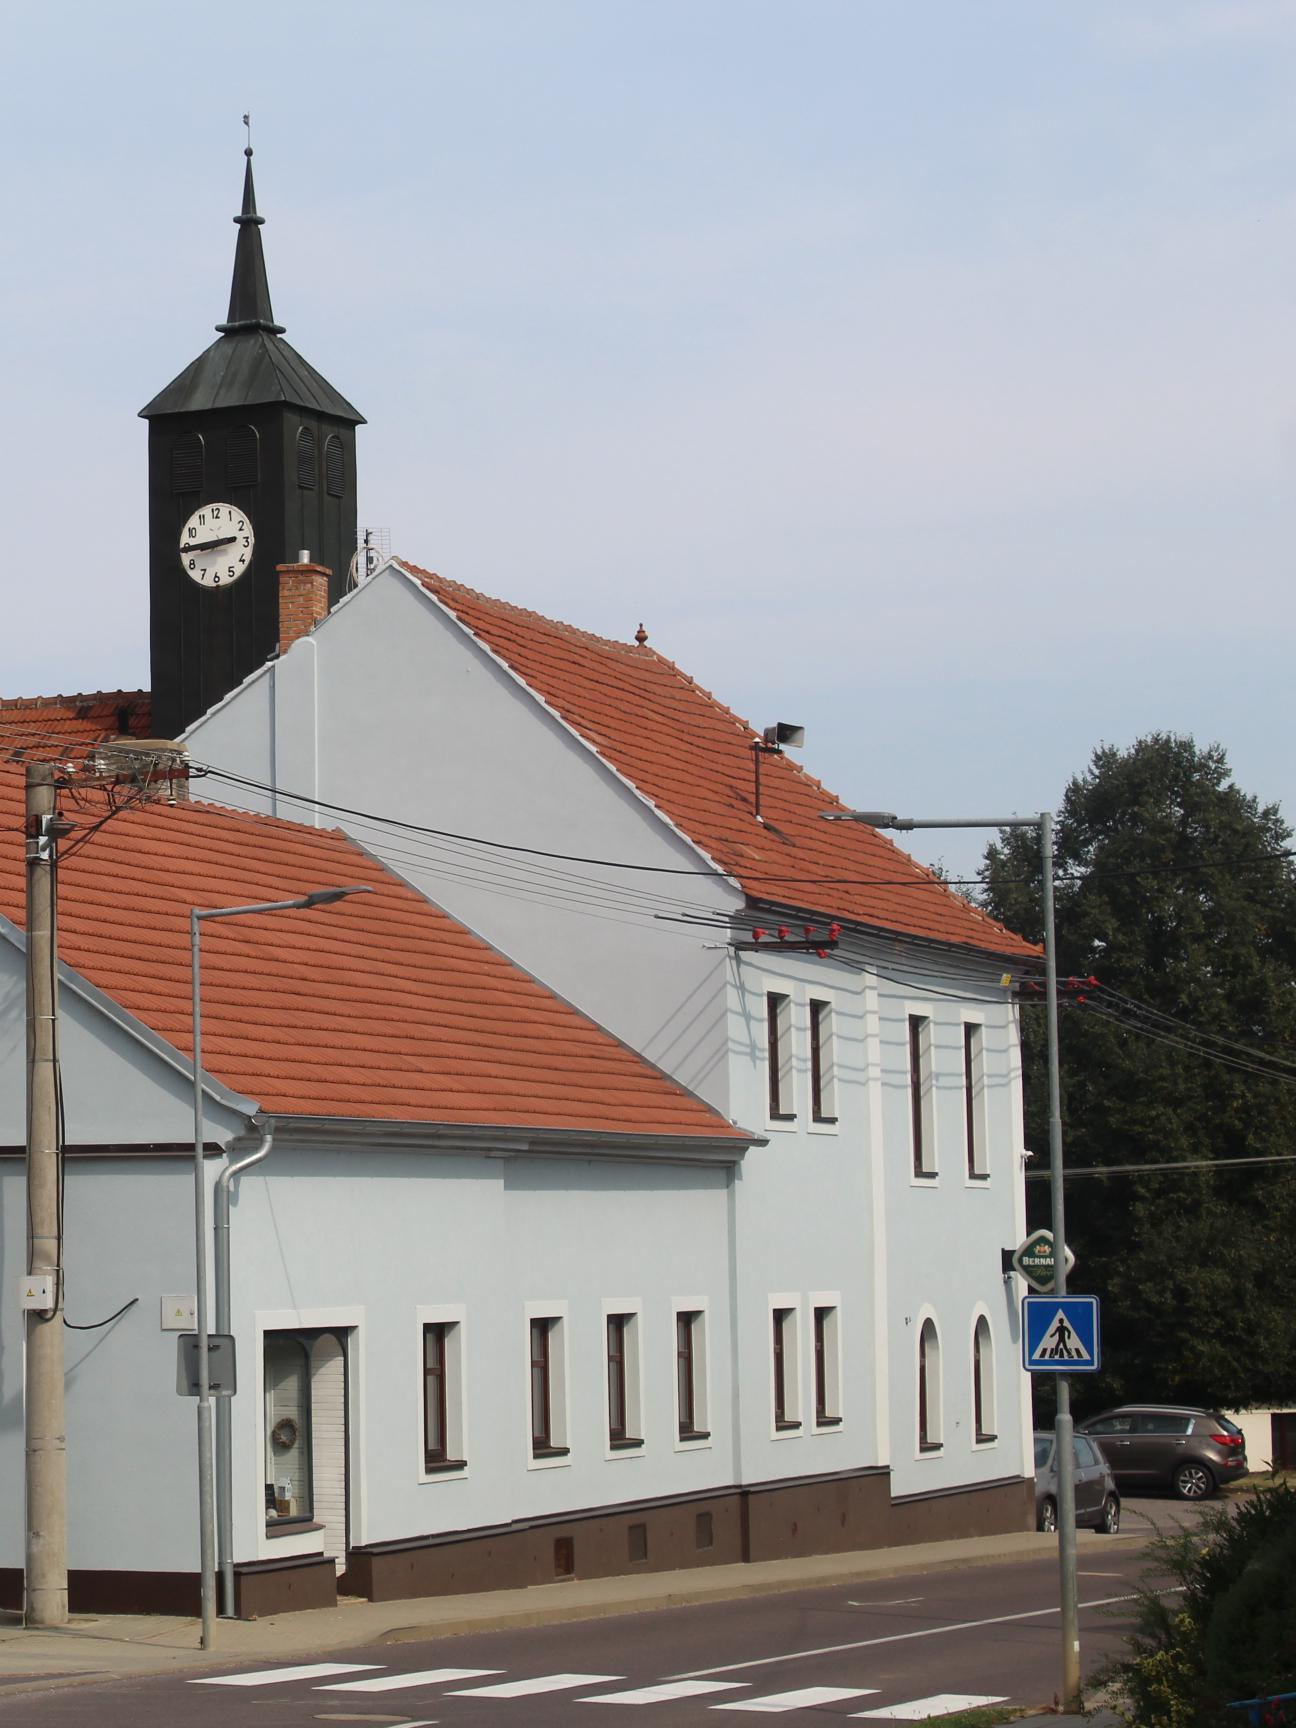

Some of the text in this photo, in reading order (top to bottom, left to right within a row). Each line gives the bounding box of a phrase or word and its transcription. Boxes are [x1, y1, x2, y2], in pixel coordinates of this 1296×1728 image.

[211, 508, 221, 519] 12
[228, 510, 232, 521] 1
[198, 514, 206, 526] 11
[237, 520, 245, 531] 2
[188, 527, 197, 538] 10
[242, 536, 250, 548] 3
[188, 559, 196, 570] 8
[238, 553, 246, 565] 4
[200, 568, 207, 580] 7
[227, 566, 235, 577] 5
[213, 572, 220, 583] 6
[1022, 1256, 1055, 1266] BERNA
